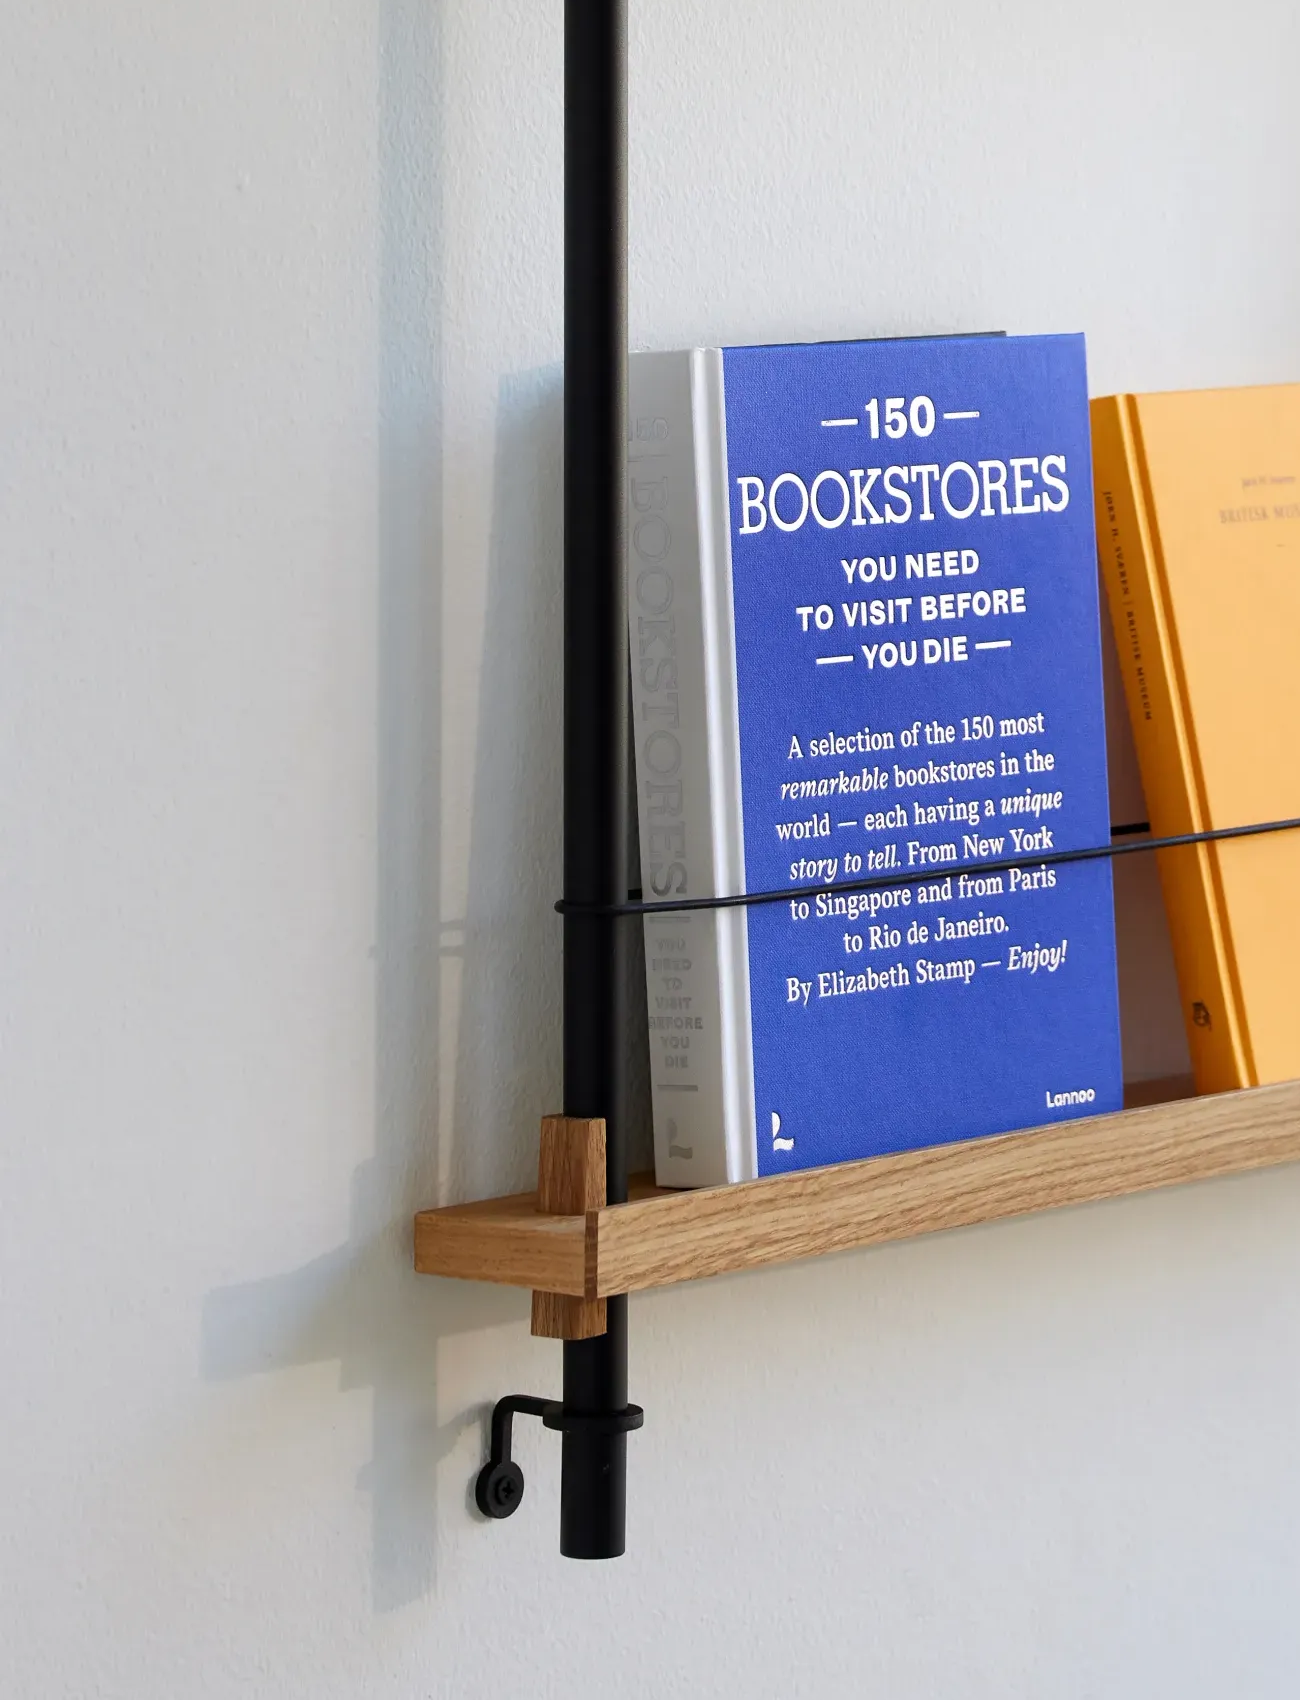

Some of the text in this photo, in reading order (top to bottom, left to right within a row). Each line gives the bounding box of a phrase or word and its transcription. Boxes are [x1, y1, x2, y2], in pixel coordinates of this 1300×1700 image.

[864, 395, 936, 441] 150
[736, 454, 1070, 536] BOOKSTORES
[840, 549, 980, 585] YOU NEED
[795, 587, 1027, 632] TO VISIT BEFORE
[860, 635, 969, 670] YOU DIE
[630, 475, 688, 898] BOOKSTORES
[1136, 666, 1153, 721] MUSEUM
[787, 712, 1045, 760] A selection of the 150 most
[780, 748, 1055, 801] remarkable bookstores in the
[774, 812, 831, 842] world
[864, 803, 909, 832] each
[912, 796, 981, 827] having
[984, 799, 996, 818] a
[999, 787, 1063, 819] unique
[789, 825, 1054, 884] story to tell. From New York
[789, 867, 1057, 921] to Singapore and from Paris
[842, 915, 1010, 954] to Rio de Janeiro.
[785, 977, 813, 1007] By
[817, 962, 911, 999] Elizabeth
[915, 958, 976, 985] Stamp
[1006, 939, 1068, 975] Enjoy!
[648, 1016, 704, 1031] BEFORE
[655, 997, 692, 1011] VISIT
[660, 1036, 691, 1050] YOU
[664, 1055, 690, 1069] DIE
[1045, 1088, 1096, 1109] Lannoo
